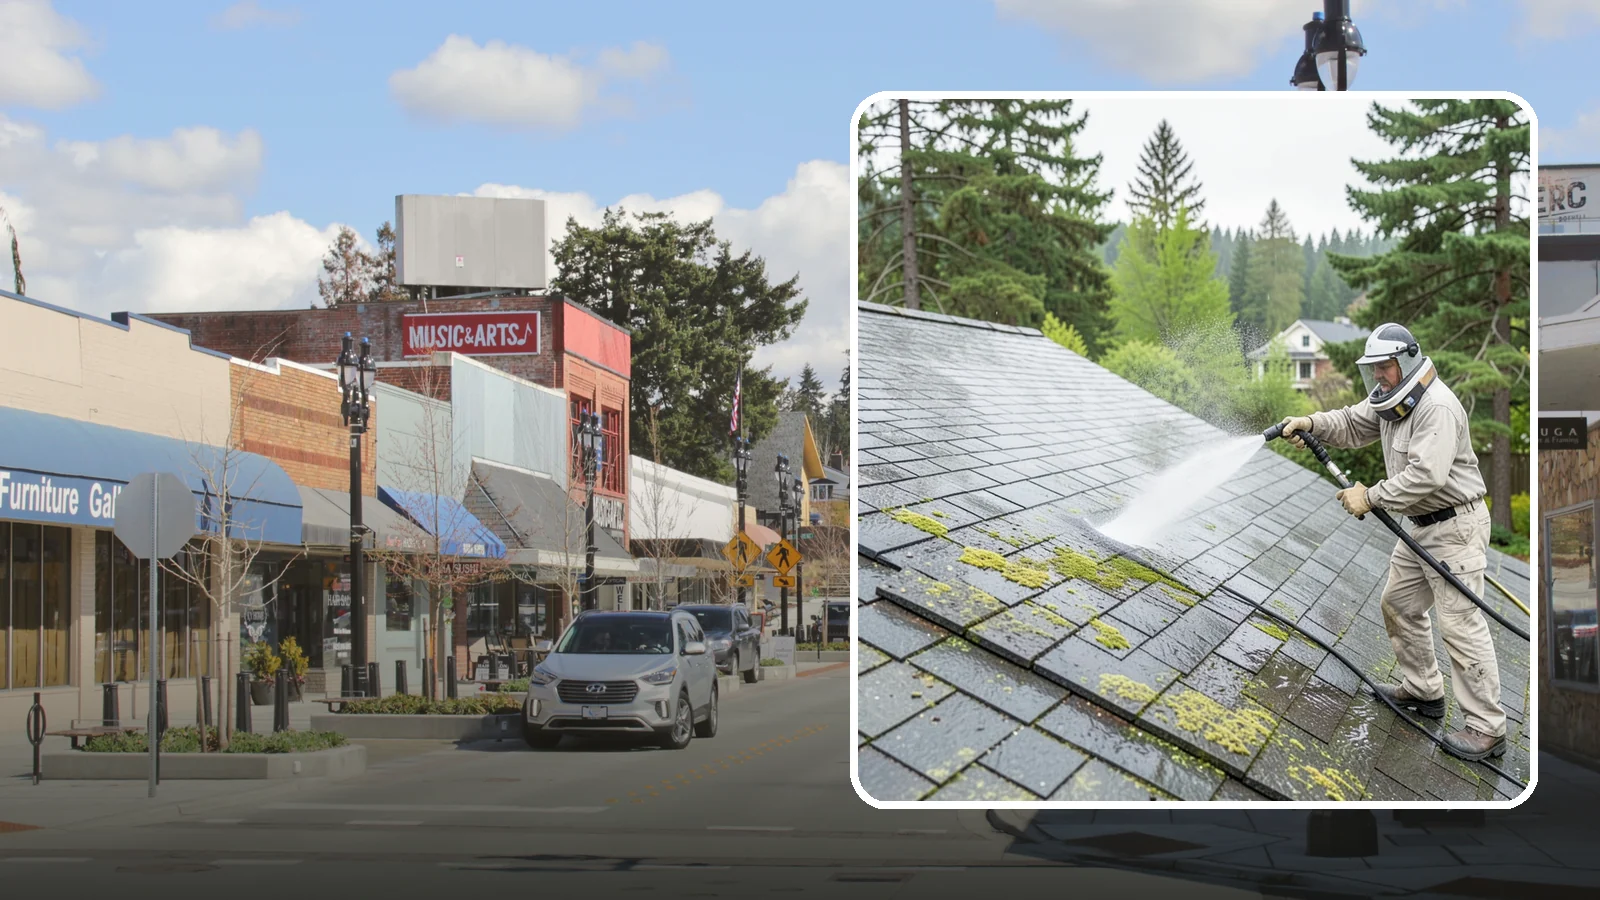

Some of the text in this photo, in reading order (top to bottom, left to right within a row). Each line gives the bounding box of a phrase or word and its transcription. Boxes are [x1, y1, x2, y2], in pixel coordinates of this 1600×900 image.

[0, 471, 121, 519] Furniture Gal
[453, 563, 479, 574] SUSHI
